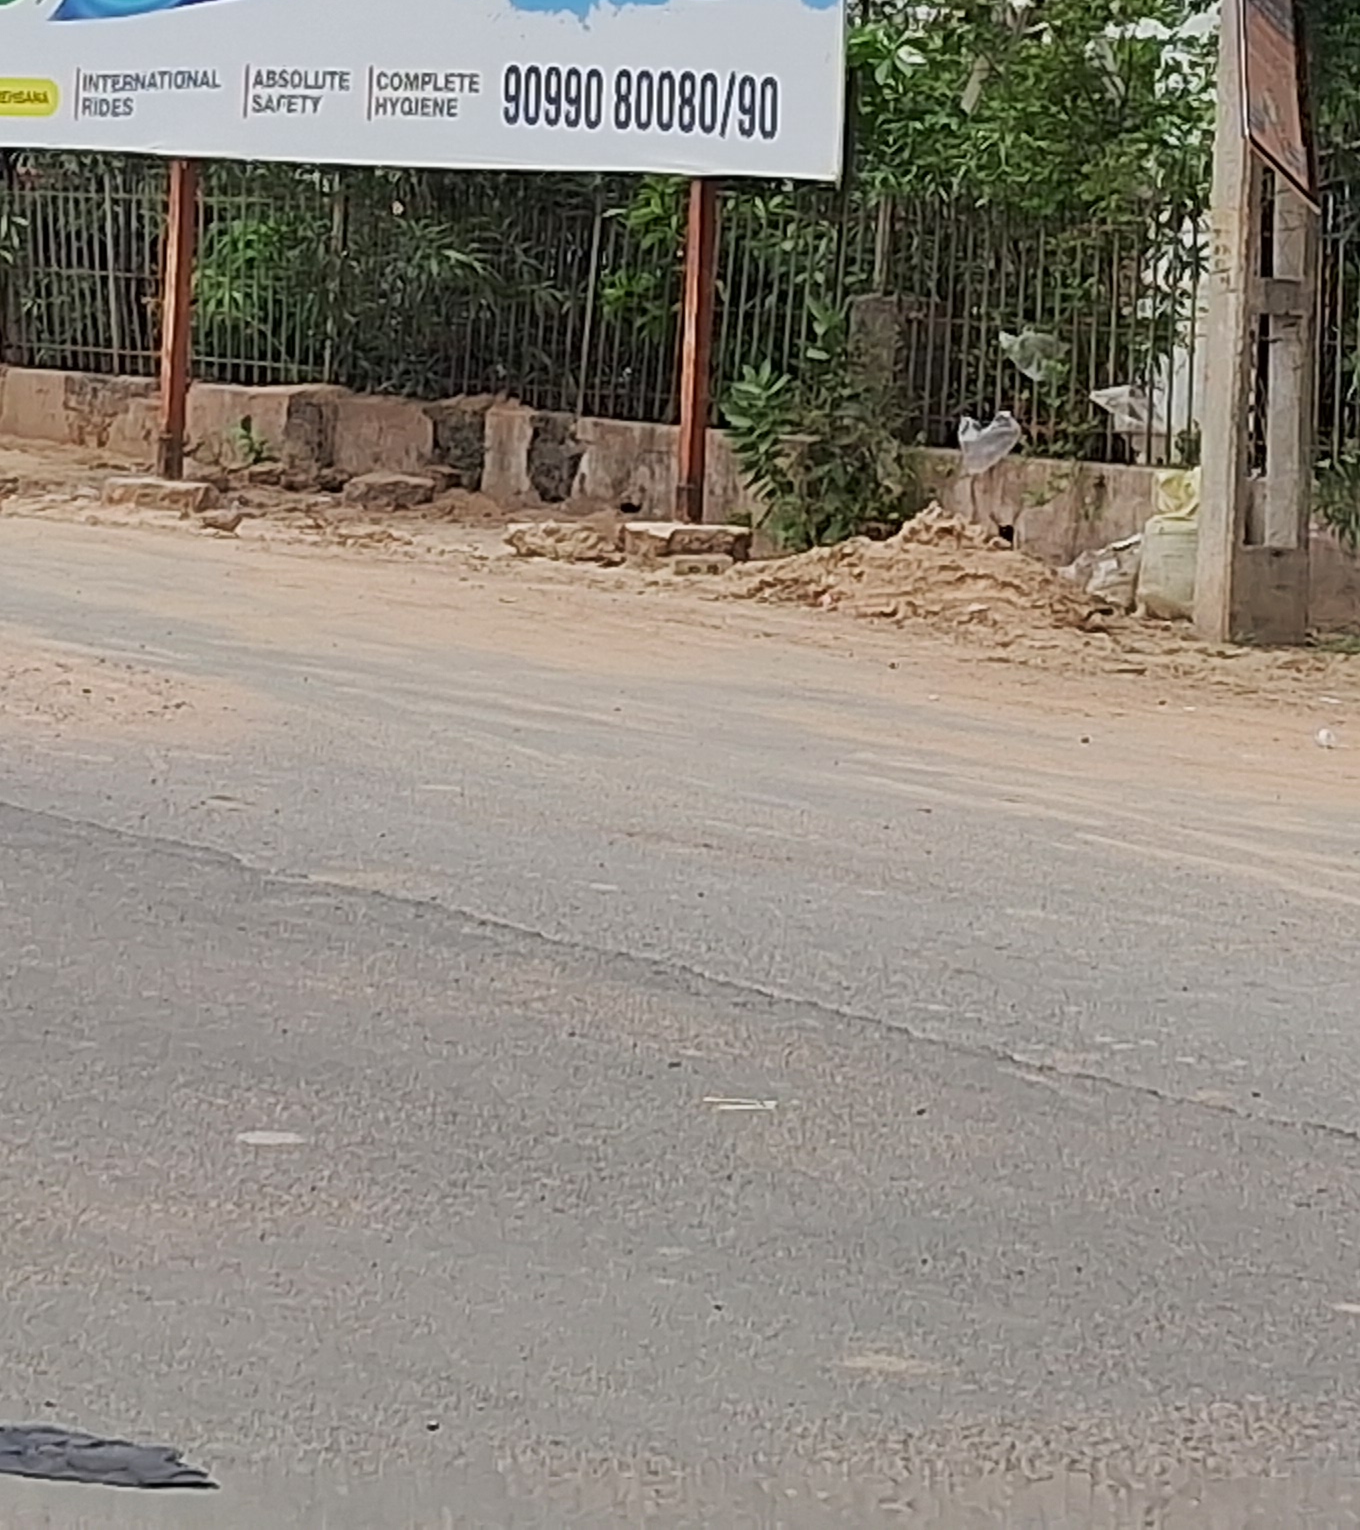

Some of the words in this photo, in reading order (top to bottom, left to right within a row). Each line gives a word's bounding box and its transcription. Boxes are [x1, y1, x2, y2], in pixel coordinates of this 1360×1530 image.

[82, 70, 222, 92] INTERNATIONAL
[252, 70, 351, 90] ABSOLUTE
[376, 72, 481, 94] COMPLETE
[82, 97, 134, 117] RIDES
[251, 95, 324, 115] SAFETY
[375, 96, 459, 118] HYGIENE
[503, 64, 603, 130] 90990
[614, 68, 778, 140] 80080/90
